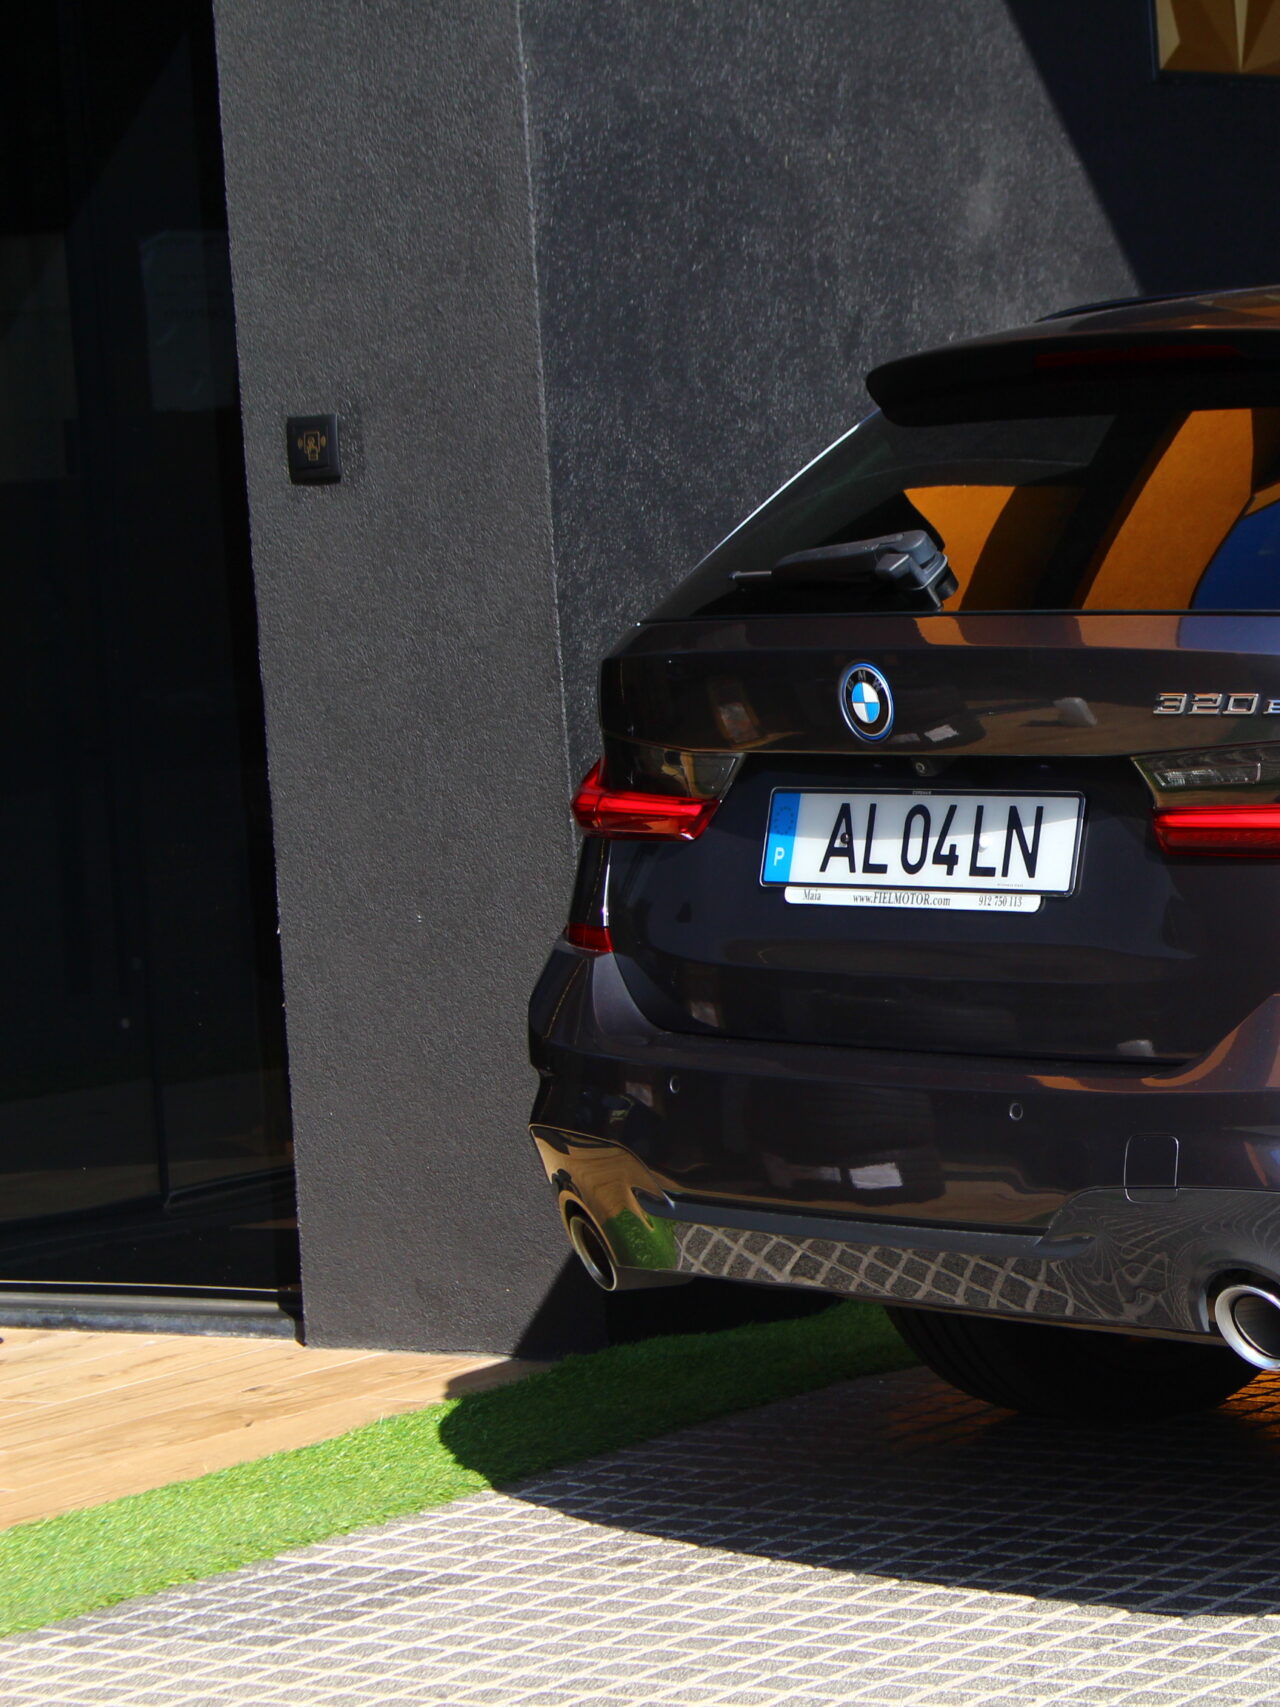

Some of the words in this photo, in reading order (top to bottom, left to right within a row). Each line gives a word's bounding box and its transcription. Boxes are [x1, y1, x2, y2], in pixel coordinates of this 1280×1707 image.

[773, 847, 785, 866] P
[803, 889, 822, 901] Maia
[853, 891, 951, 906] www.FIELMOTOR.com
